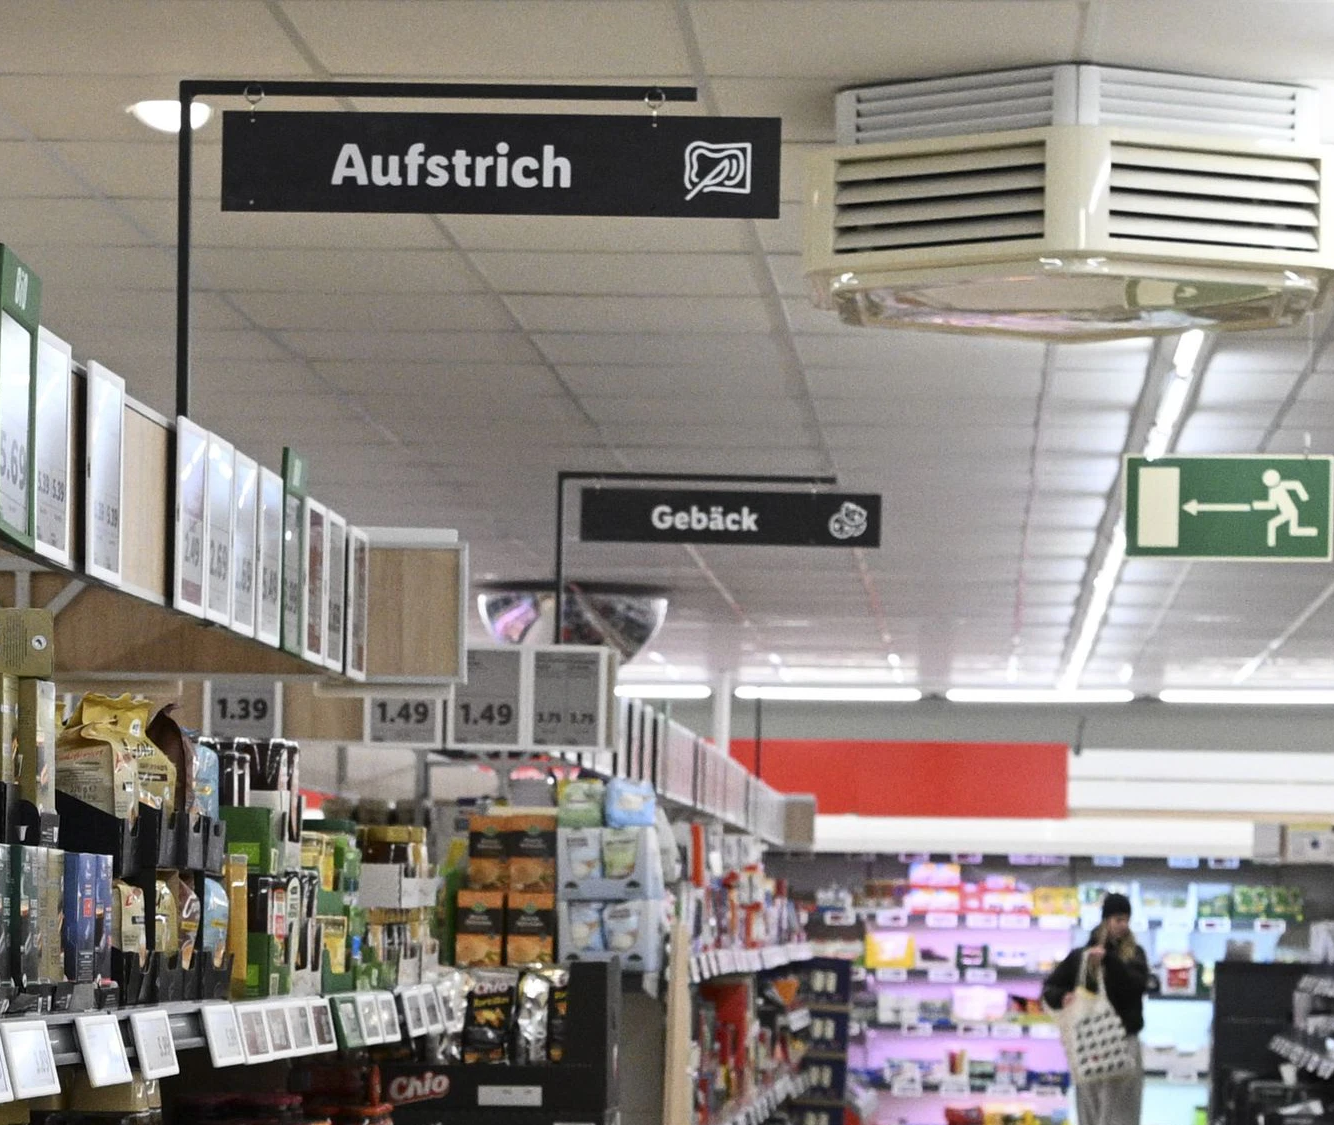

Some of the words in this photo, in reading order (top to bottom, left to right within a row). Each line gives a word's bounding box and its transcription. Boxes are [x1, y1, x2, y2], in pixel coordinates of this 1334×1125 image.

[331, 142, 571, 189] Aufstrich
[651, 505, 759, 534] Gebäck
[218, 698, 267, 721] 1.39
[378, 701, 429, 724] 1.49
[460, 703, 513, 726] 1.49
[389, 1072, 450, 1101] Chio
